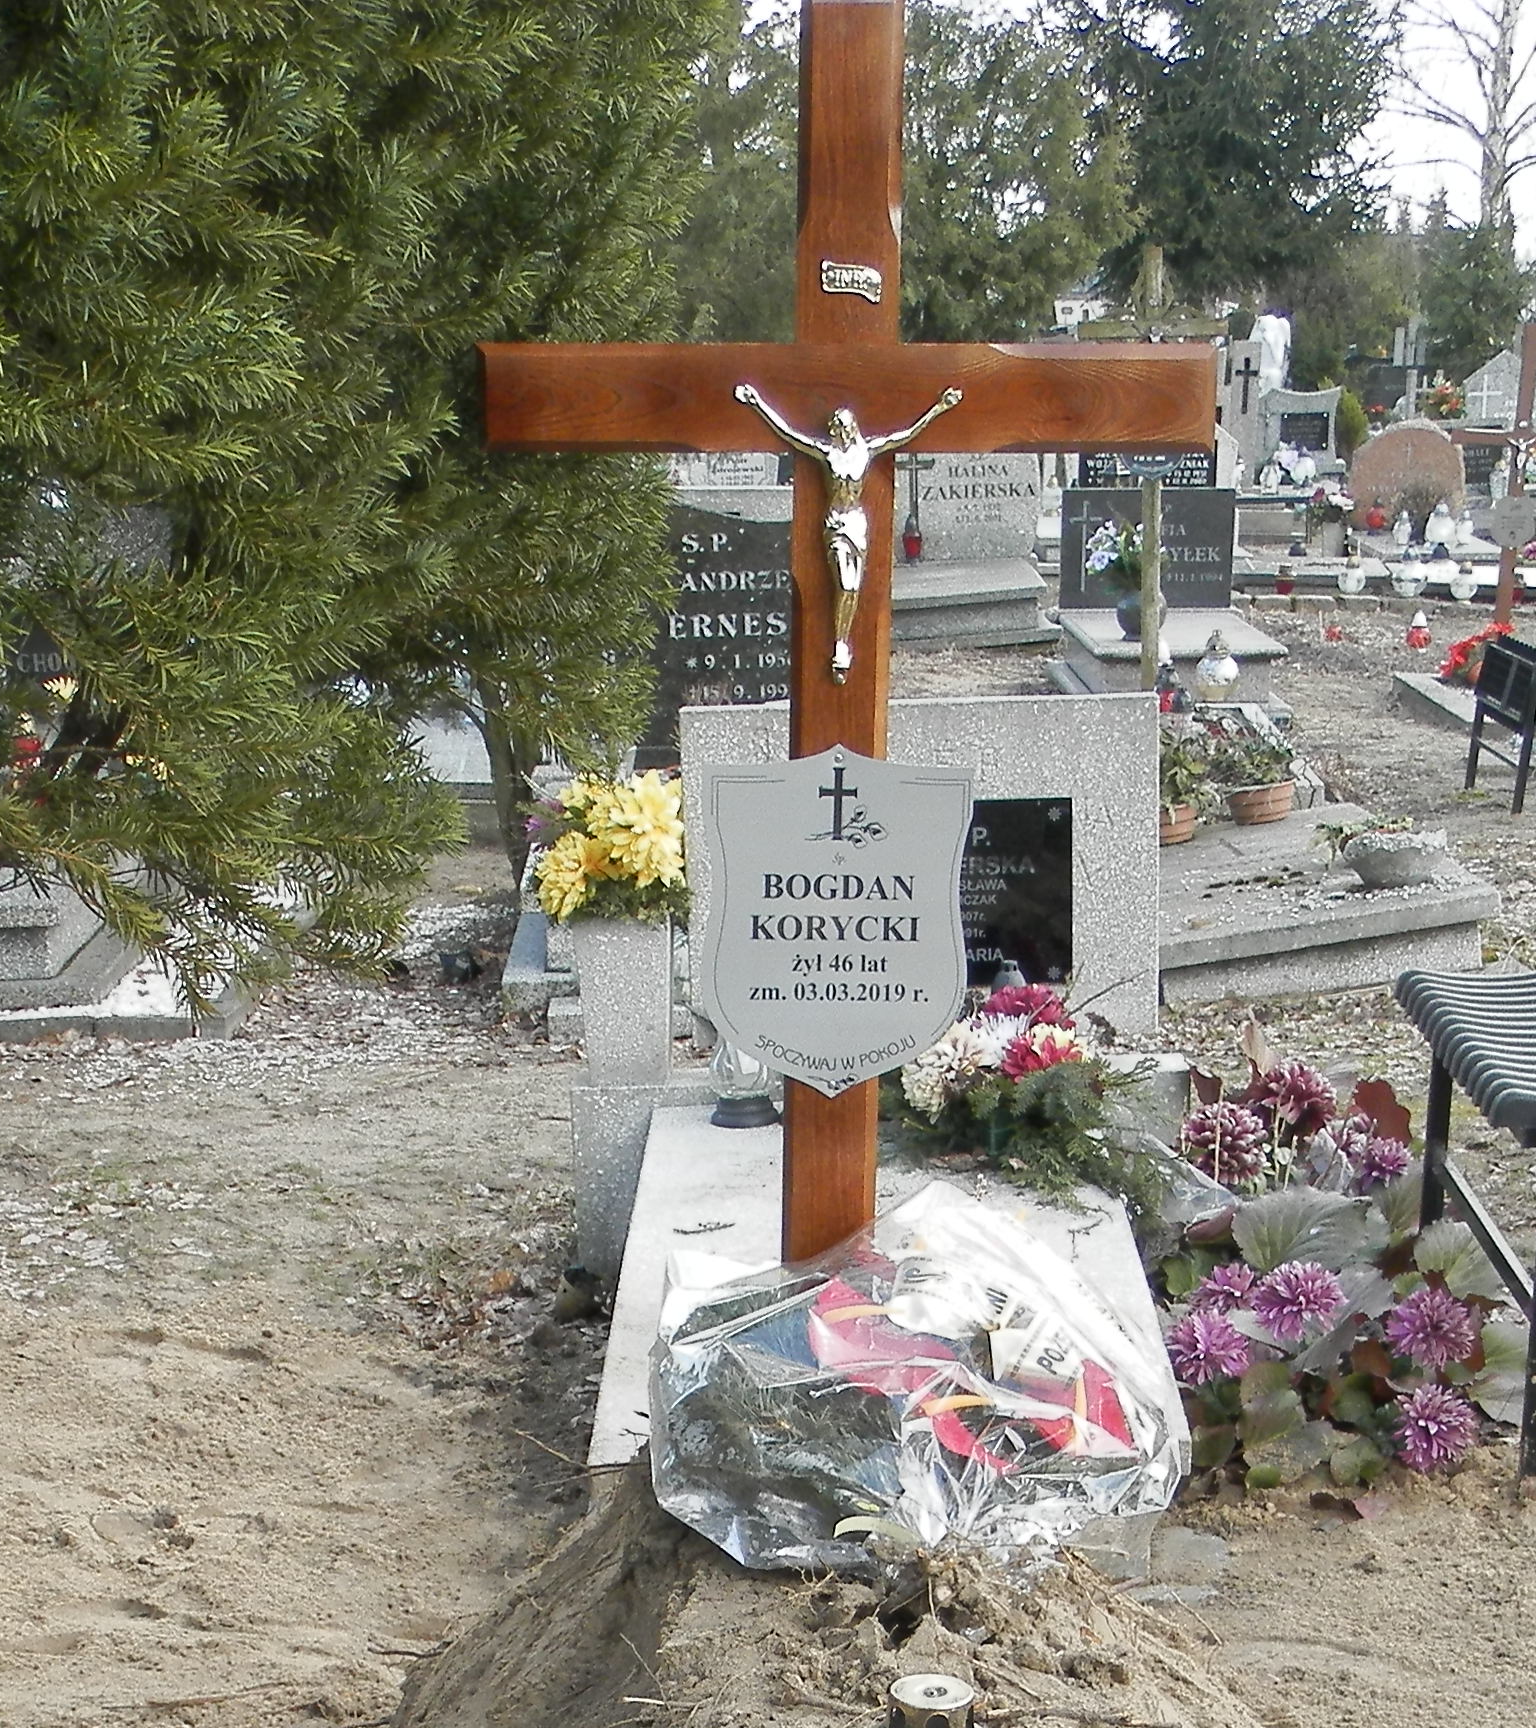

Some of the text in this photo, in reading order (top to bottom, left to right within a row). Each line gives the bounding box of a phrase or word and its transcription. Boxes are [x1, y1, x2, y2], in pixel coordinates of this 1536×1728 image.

[833, 268, 873, 290] INR
[948, 464, 1009, 478] HALINA
[921, 481, 1036, 501] ZAKIERSKA
[763, 873, 915, 900] BOGDAN
[961, 893, 997, 906] CZAK
[750, 914, 921, 942] KORYCKI
[828, 953, 854, 973] 46
[860, 954, 889, 973] lat
[749, 982, 929, 1003] zm. 03.03.2019 r.
[754, 1034, 917, 1071] SPOCZYWAJ W POKOJU
